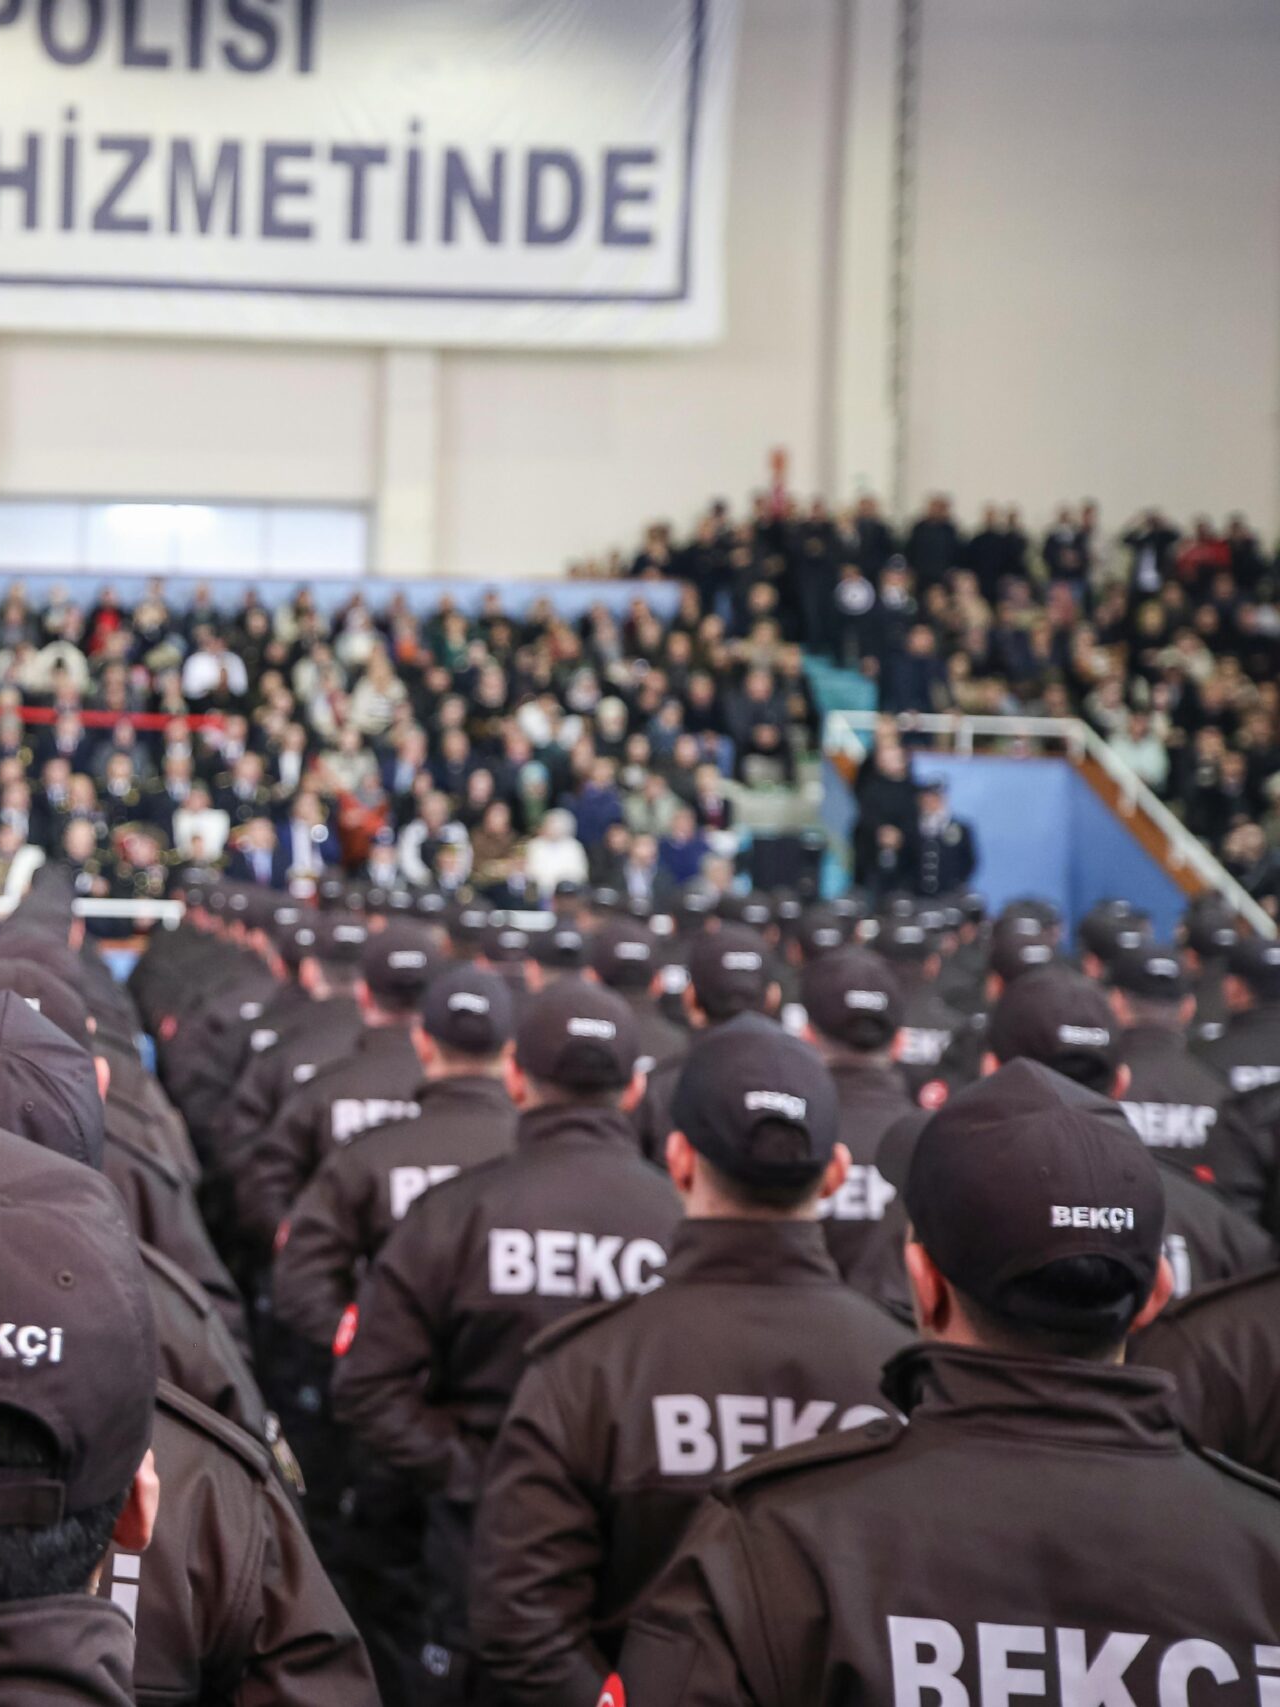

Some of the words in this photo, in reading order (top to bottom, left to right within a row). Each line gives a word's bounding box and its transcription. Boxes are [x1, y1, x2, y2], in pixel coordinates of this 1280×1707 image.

[1051, 1205, 1134, 1233] BEKÇİ
[489, 1228, 667, 1299] BEKÇ
[652, 1393, 909, 1475] BEK
[886, 1614, 1280, 1707] BEK
